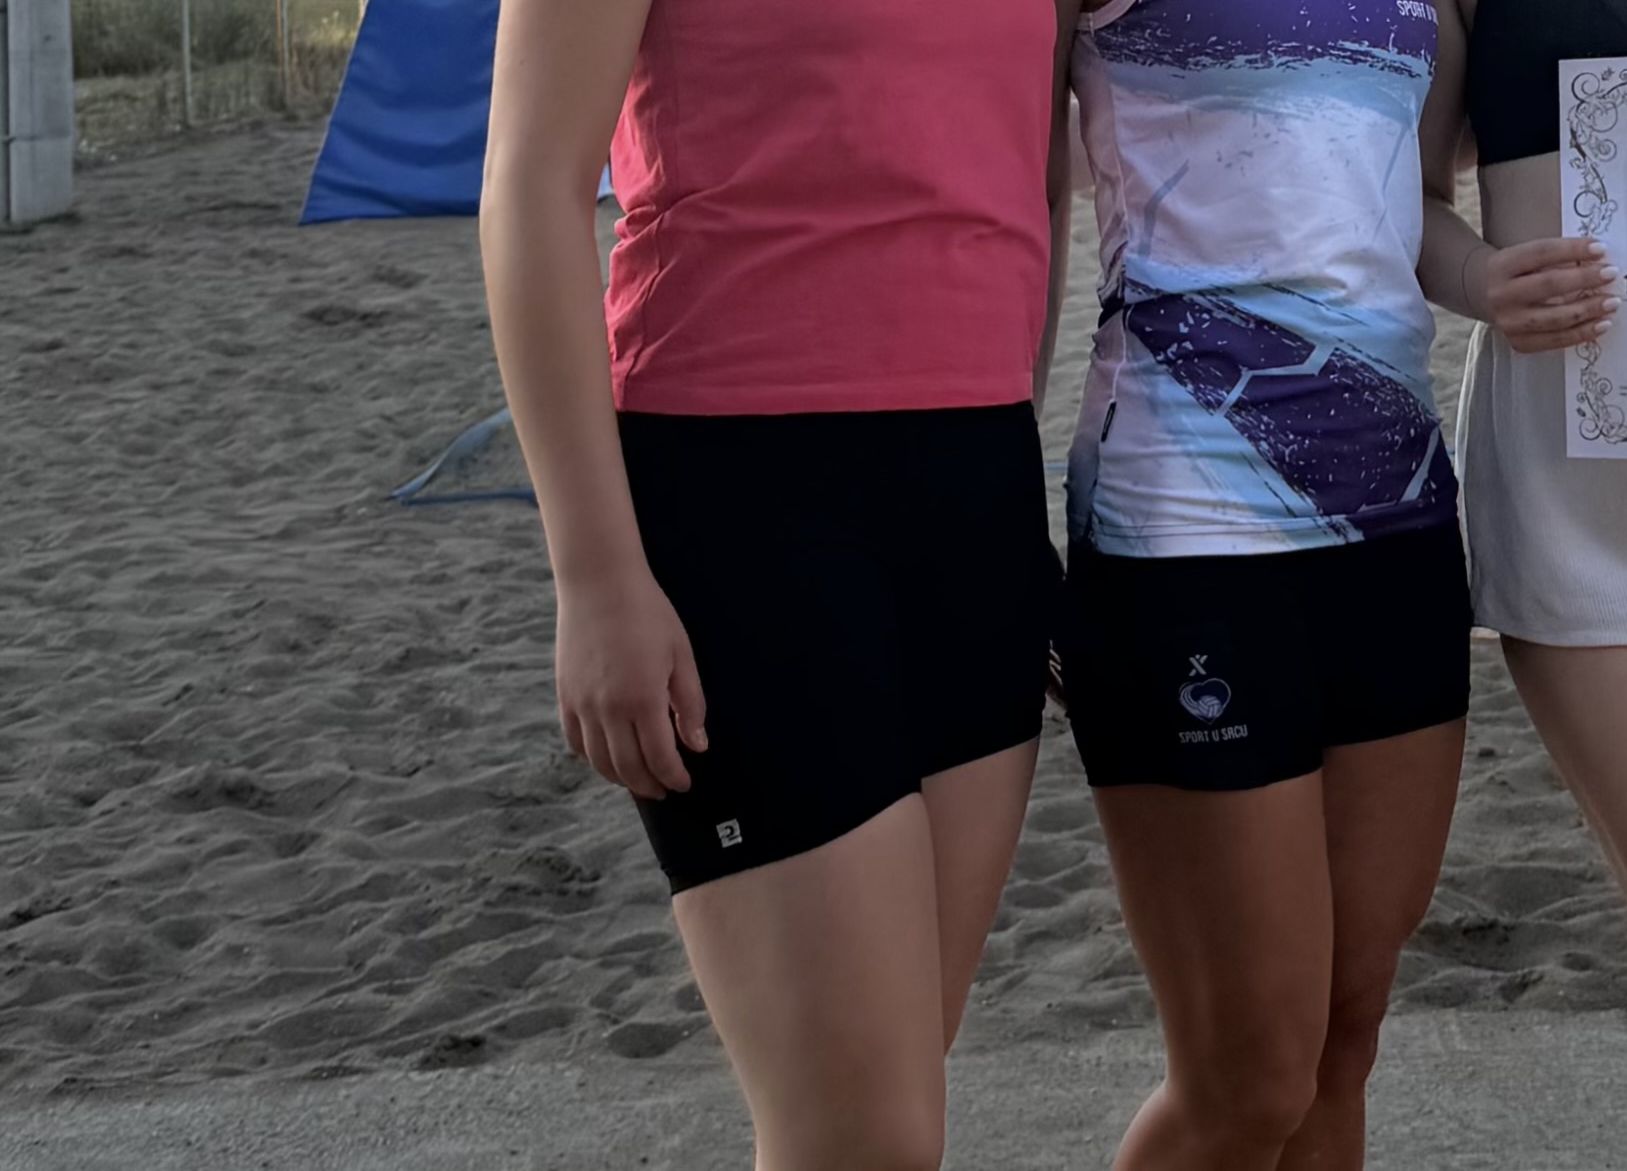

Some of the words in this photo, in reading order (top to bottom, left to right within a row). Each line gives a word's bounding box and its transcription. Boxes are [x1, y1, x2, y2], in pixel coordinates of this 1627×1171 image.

[1179, 730, 1209, 743] SPORT
[1211, 729, 1220, 742] U
[1220, 724, 1248, 741] SRCU
